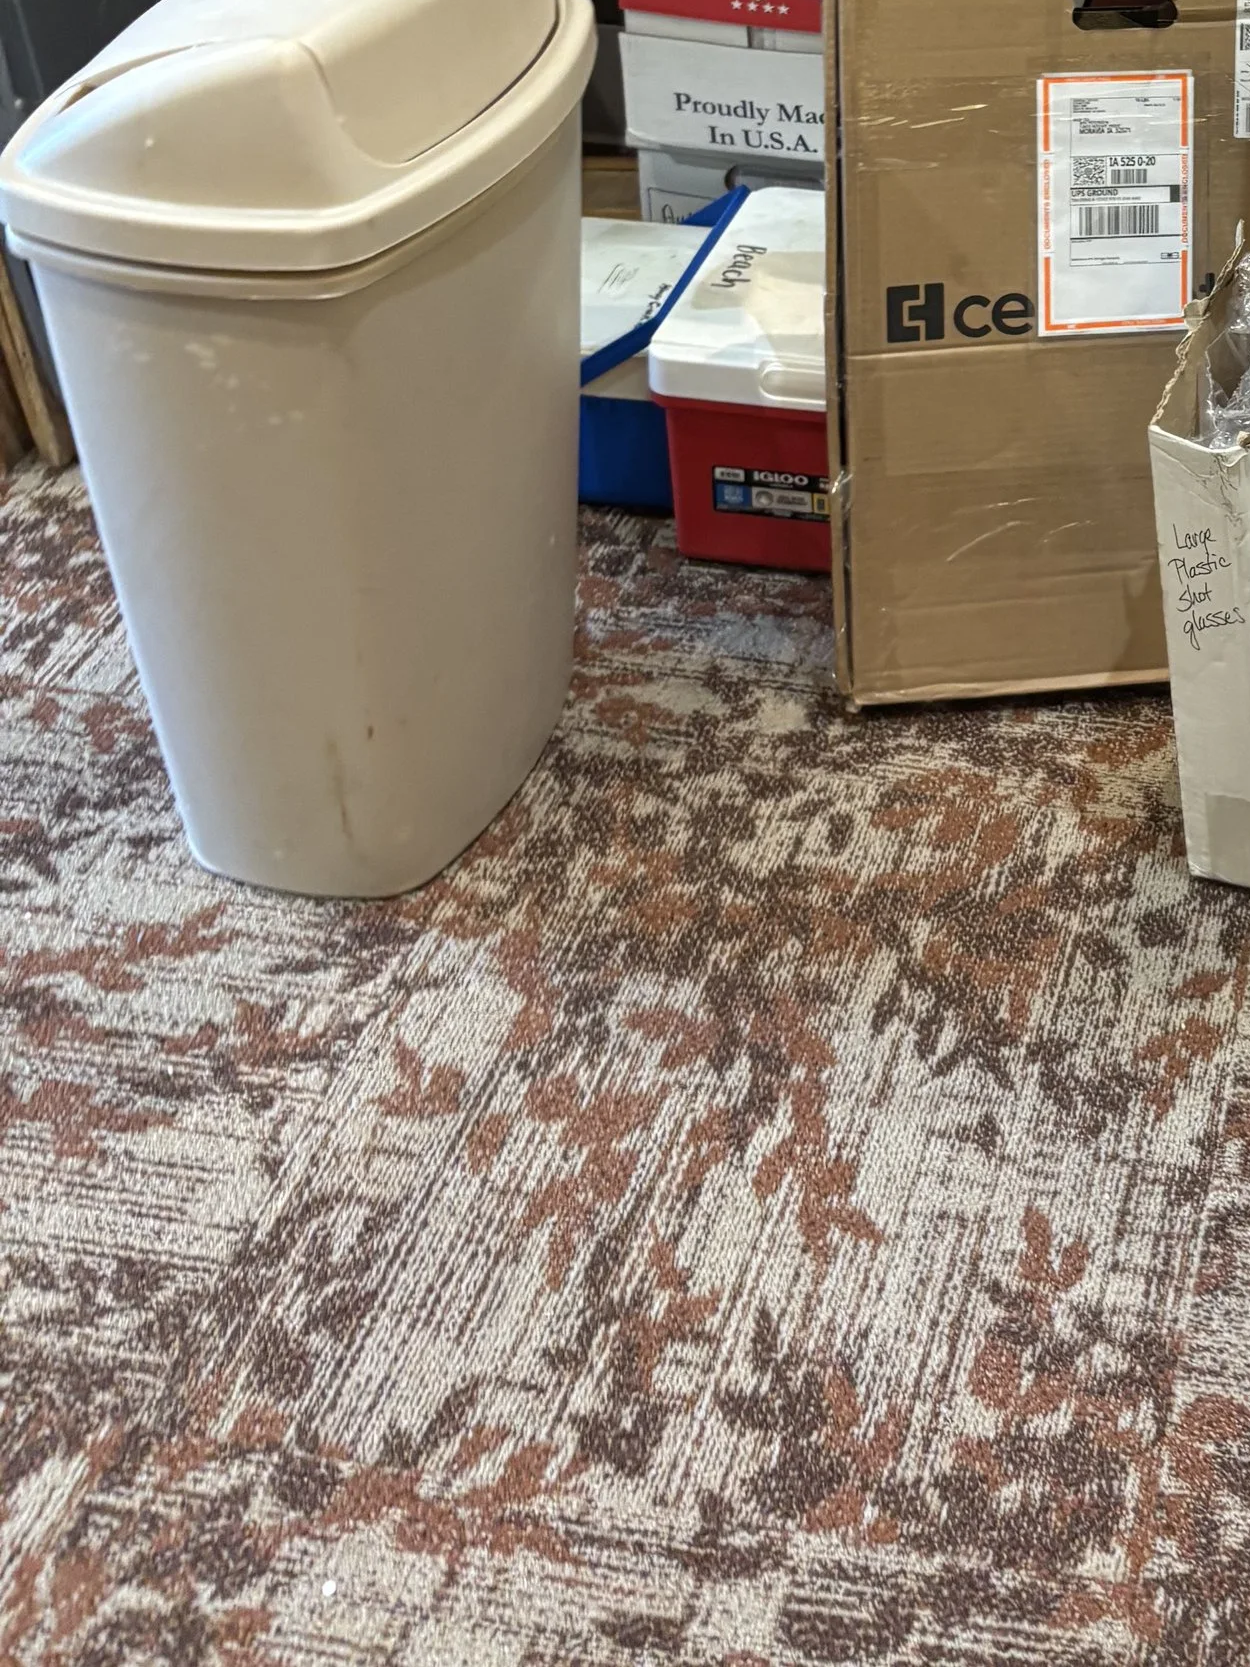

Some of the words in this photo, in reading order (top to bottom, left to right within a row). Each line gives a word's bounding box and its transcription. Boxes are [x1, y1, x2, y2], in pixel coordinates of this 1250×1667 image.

[673, 92, 770, 126] Proudly
[708, 125, 734, 146] In
[742, 130, 819, 153] U.S.A.
[1109, 156, 1119, 167] IA
[1120, 156, 1136, 167] 525
[1071, 189, 1086, 197] UPS
[1087, 188, 1119, 197] GROUND
[710, 244, 767, 289] Beach
[753, 470, 809, 486] IGLOO
[1172, 524, 1216, 556] Large
[1168, 553, 1232, 584] Plastic
[1183, 607, 1246, 651] glasses
